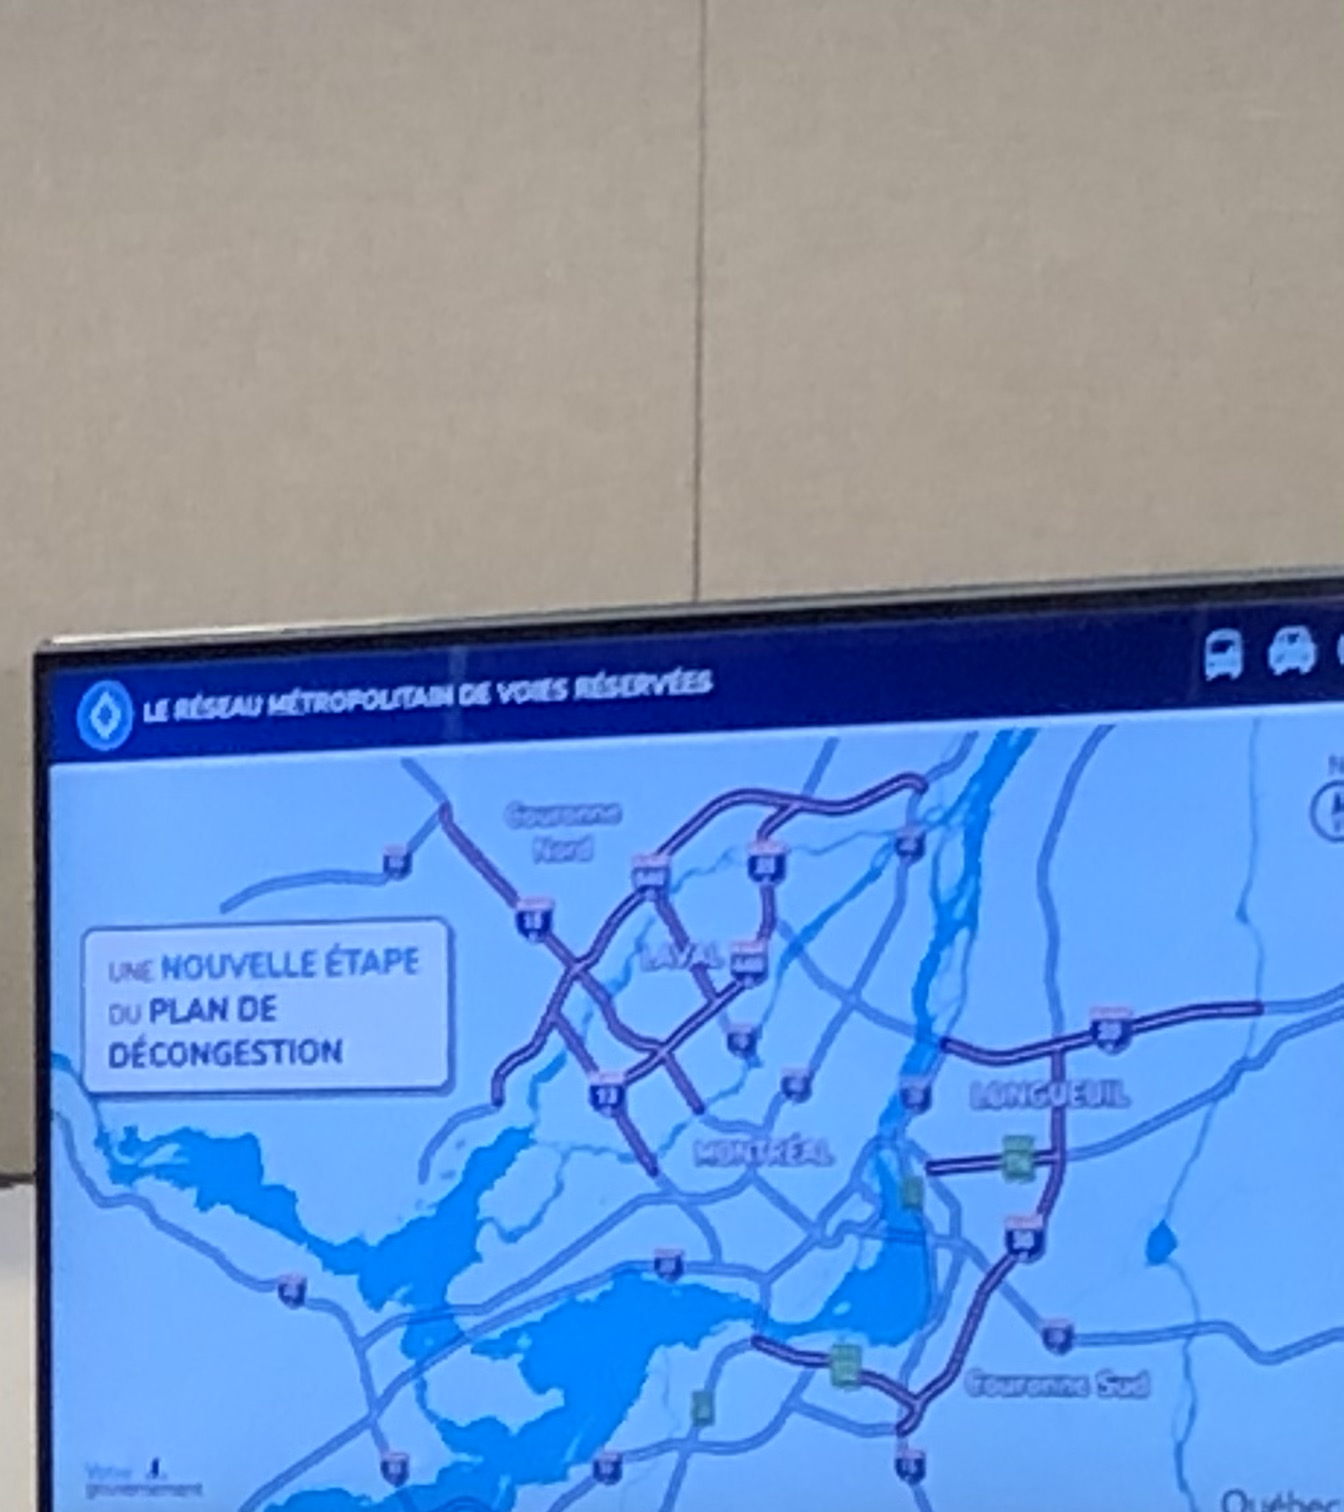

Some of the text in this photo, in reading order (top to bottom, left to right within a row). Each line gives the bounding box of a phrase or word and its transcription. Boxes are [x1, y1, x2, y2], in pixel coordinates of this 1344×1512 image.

[143, 666, 714, 723] LE RÉSEAU MÉTROPOLITAIN DE VOIES RÉSERVÉES
[109, 943, 420, 983] UNE NOUVELLE ÉTAPE
[109, 994, 278, 1025] DU PLAN DE
[109, 1034, 344, 1069] DÉCONGESTION
